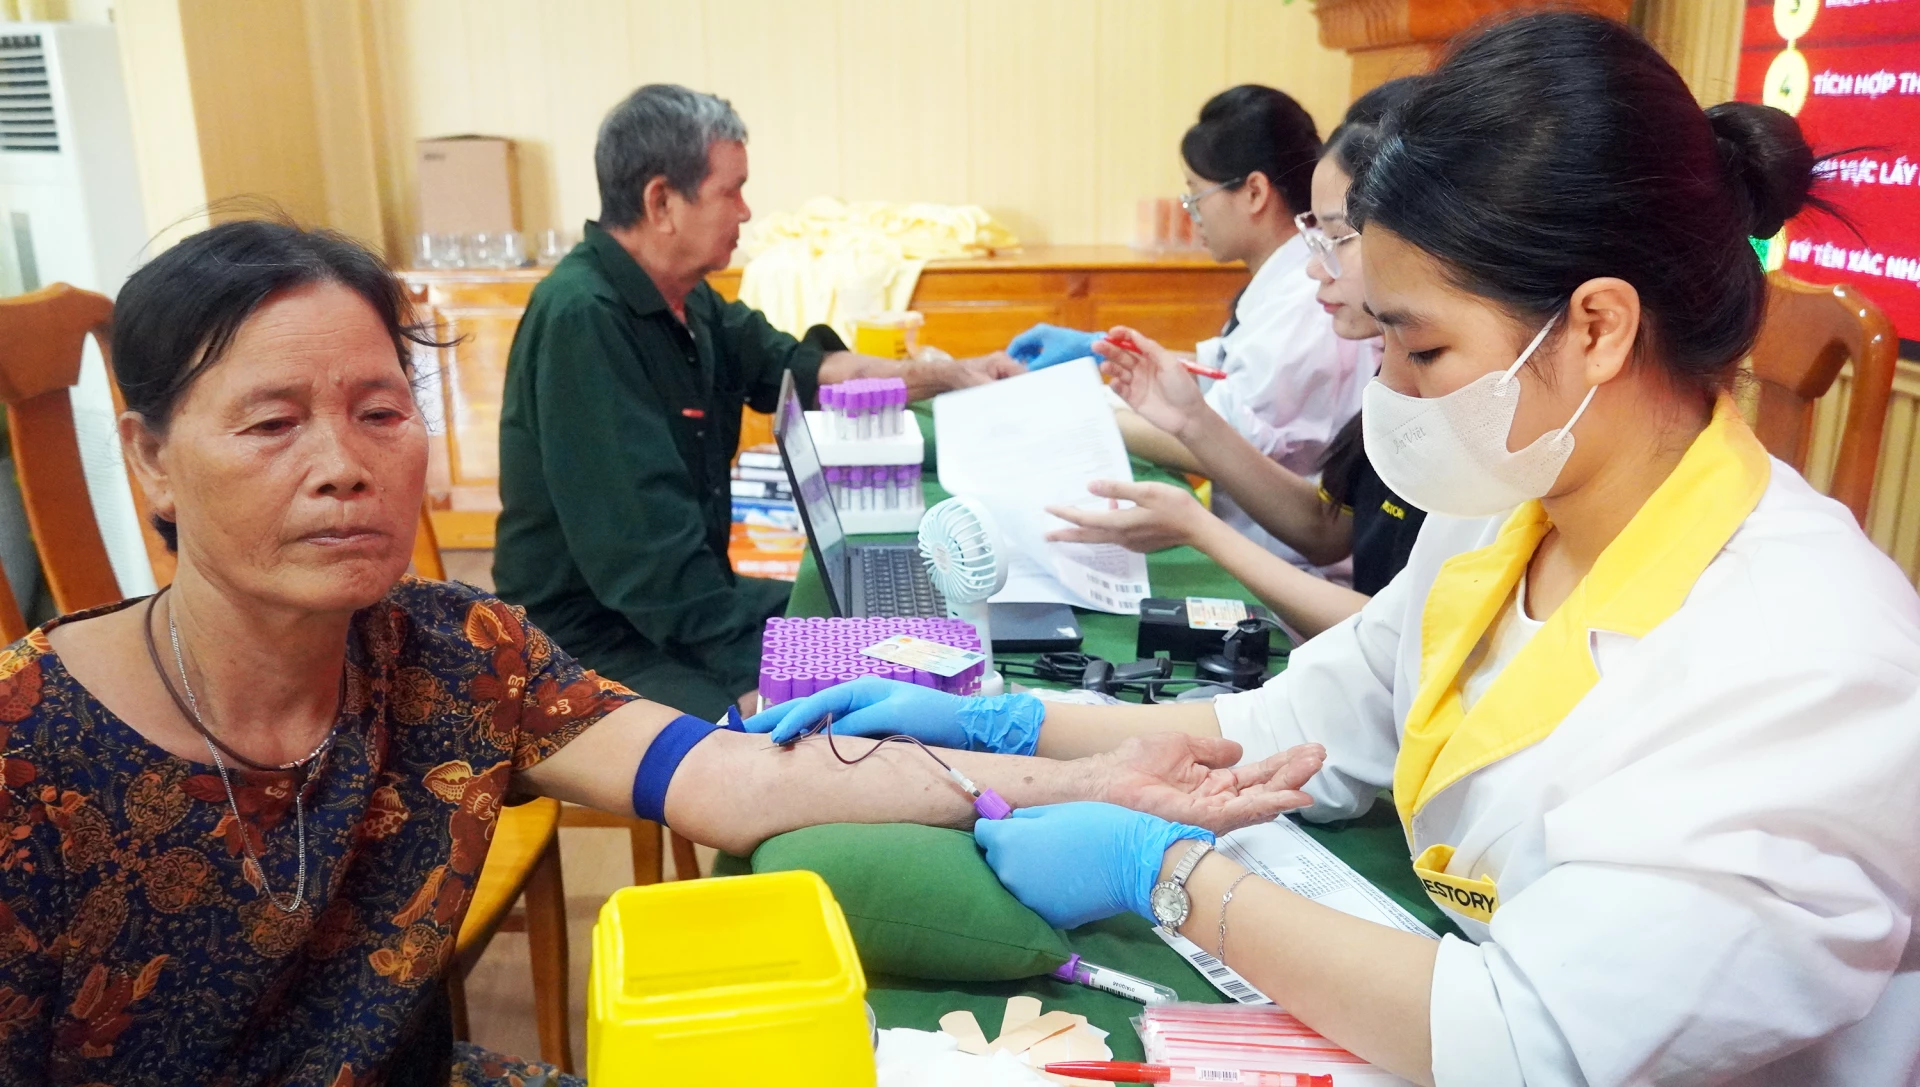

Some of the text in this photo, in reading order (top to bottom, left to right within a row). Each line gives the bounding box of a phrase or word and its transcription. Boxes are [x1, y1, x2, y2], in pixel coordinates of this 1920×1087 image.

[1812, 68, 1853, 95] TÍCH
[1853, 68, 1896, 100] HỢP
[1879, 155, 1918, 186] LẤY
[1812, 241, 1846, 270] TÊN
[1847, 247, 1884, 275] XÁC
[1421, 878, 1495, 914] ESTORY
